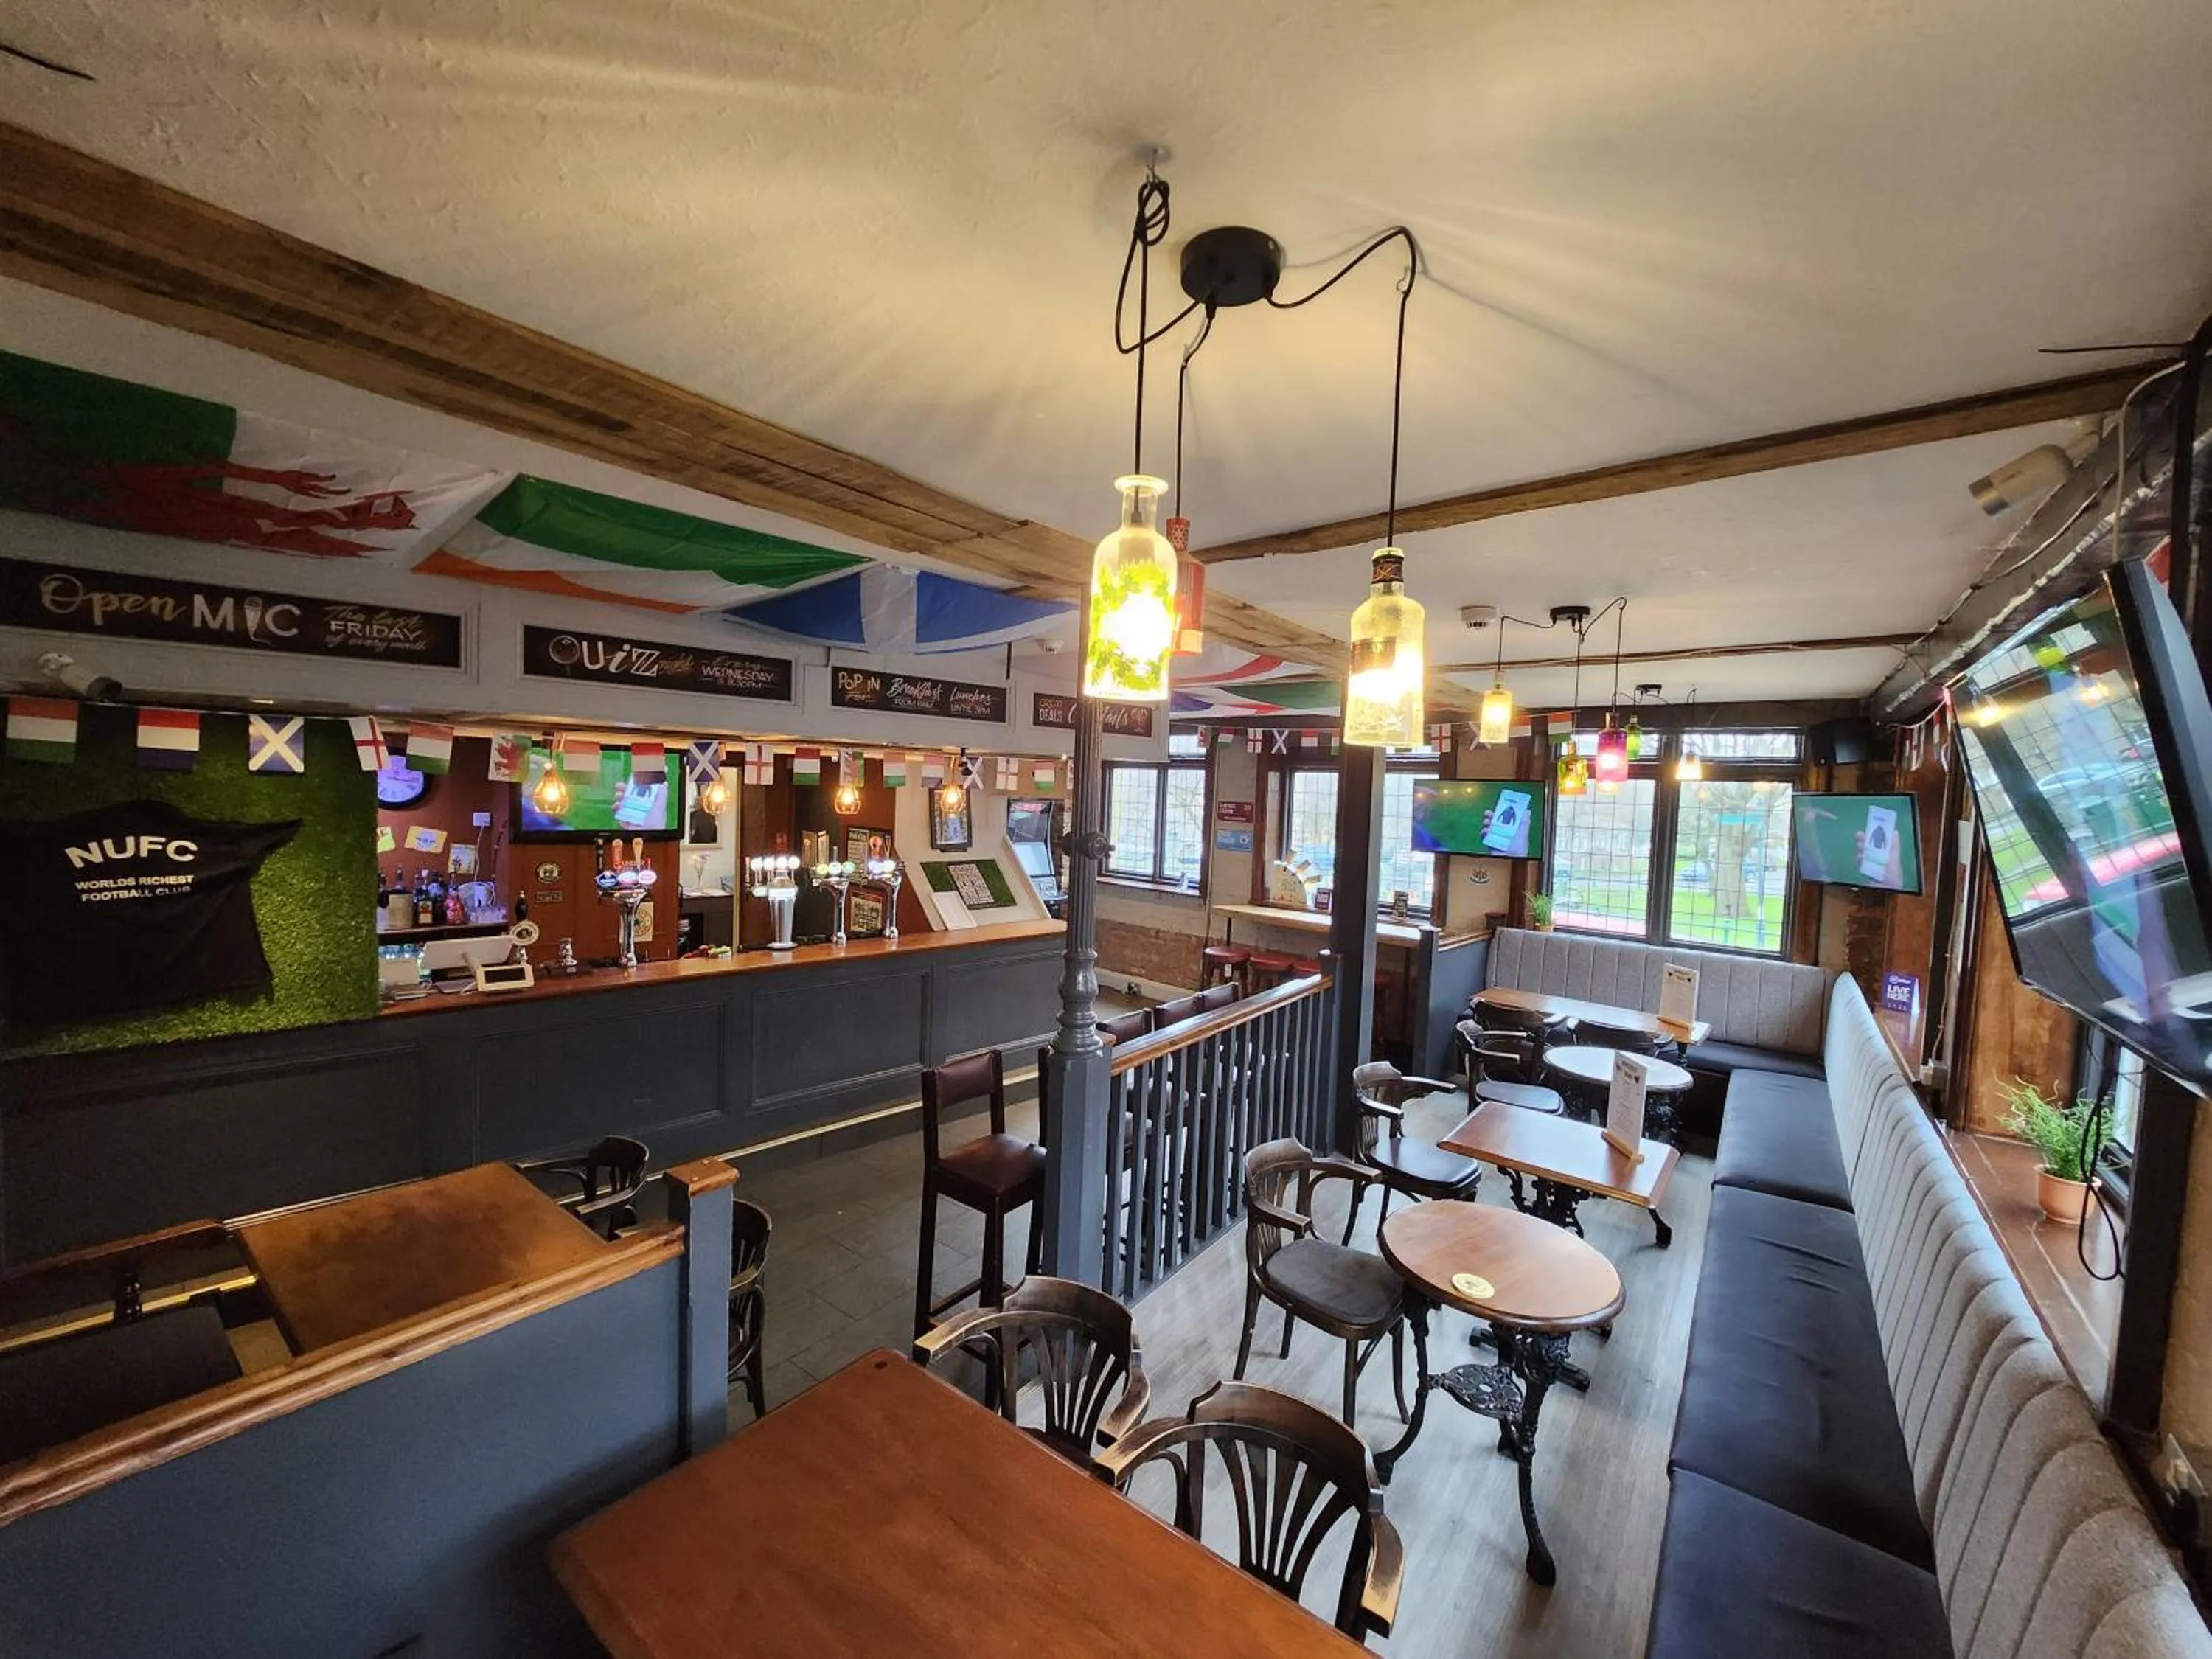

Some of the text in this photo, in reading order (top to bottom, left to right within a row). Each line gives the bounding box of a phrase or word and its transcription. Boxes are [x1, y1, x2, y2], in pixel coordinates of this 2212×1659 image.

[40, 574, 186, 625] Open
[330, 620, 422, 641] FRIDAY
[702, 665, 773, 682] WEDNESDAY
[867, 676, 880, 692] IN
[950, 685, 992, 706] Lunches
[1039, 708, 1062, 723] DEALS
[65, 836, 198, 868] NUFC
[75, 874, 194, 890] WORLDS RICHEST
[81, 886, 191, 901] FOOTBALL CLUB
[1888, 984, 1910, 994] LIVE
